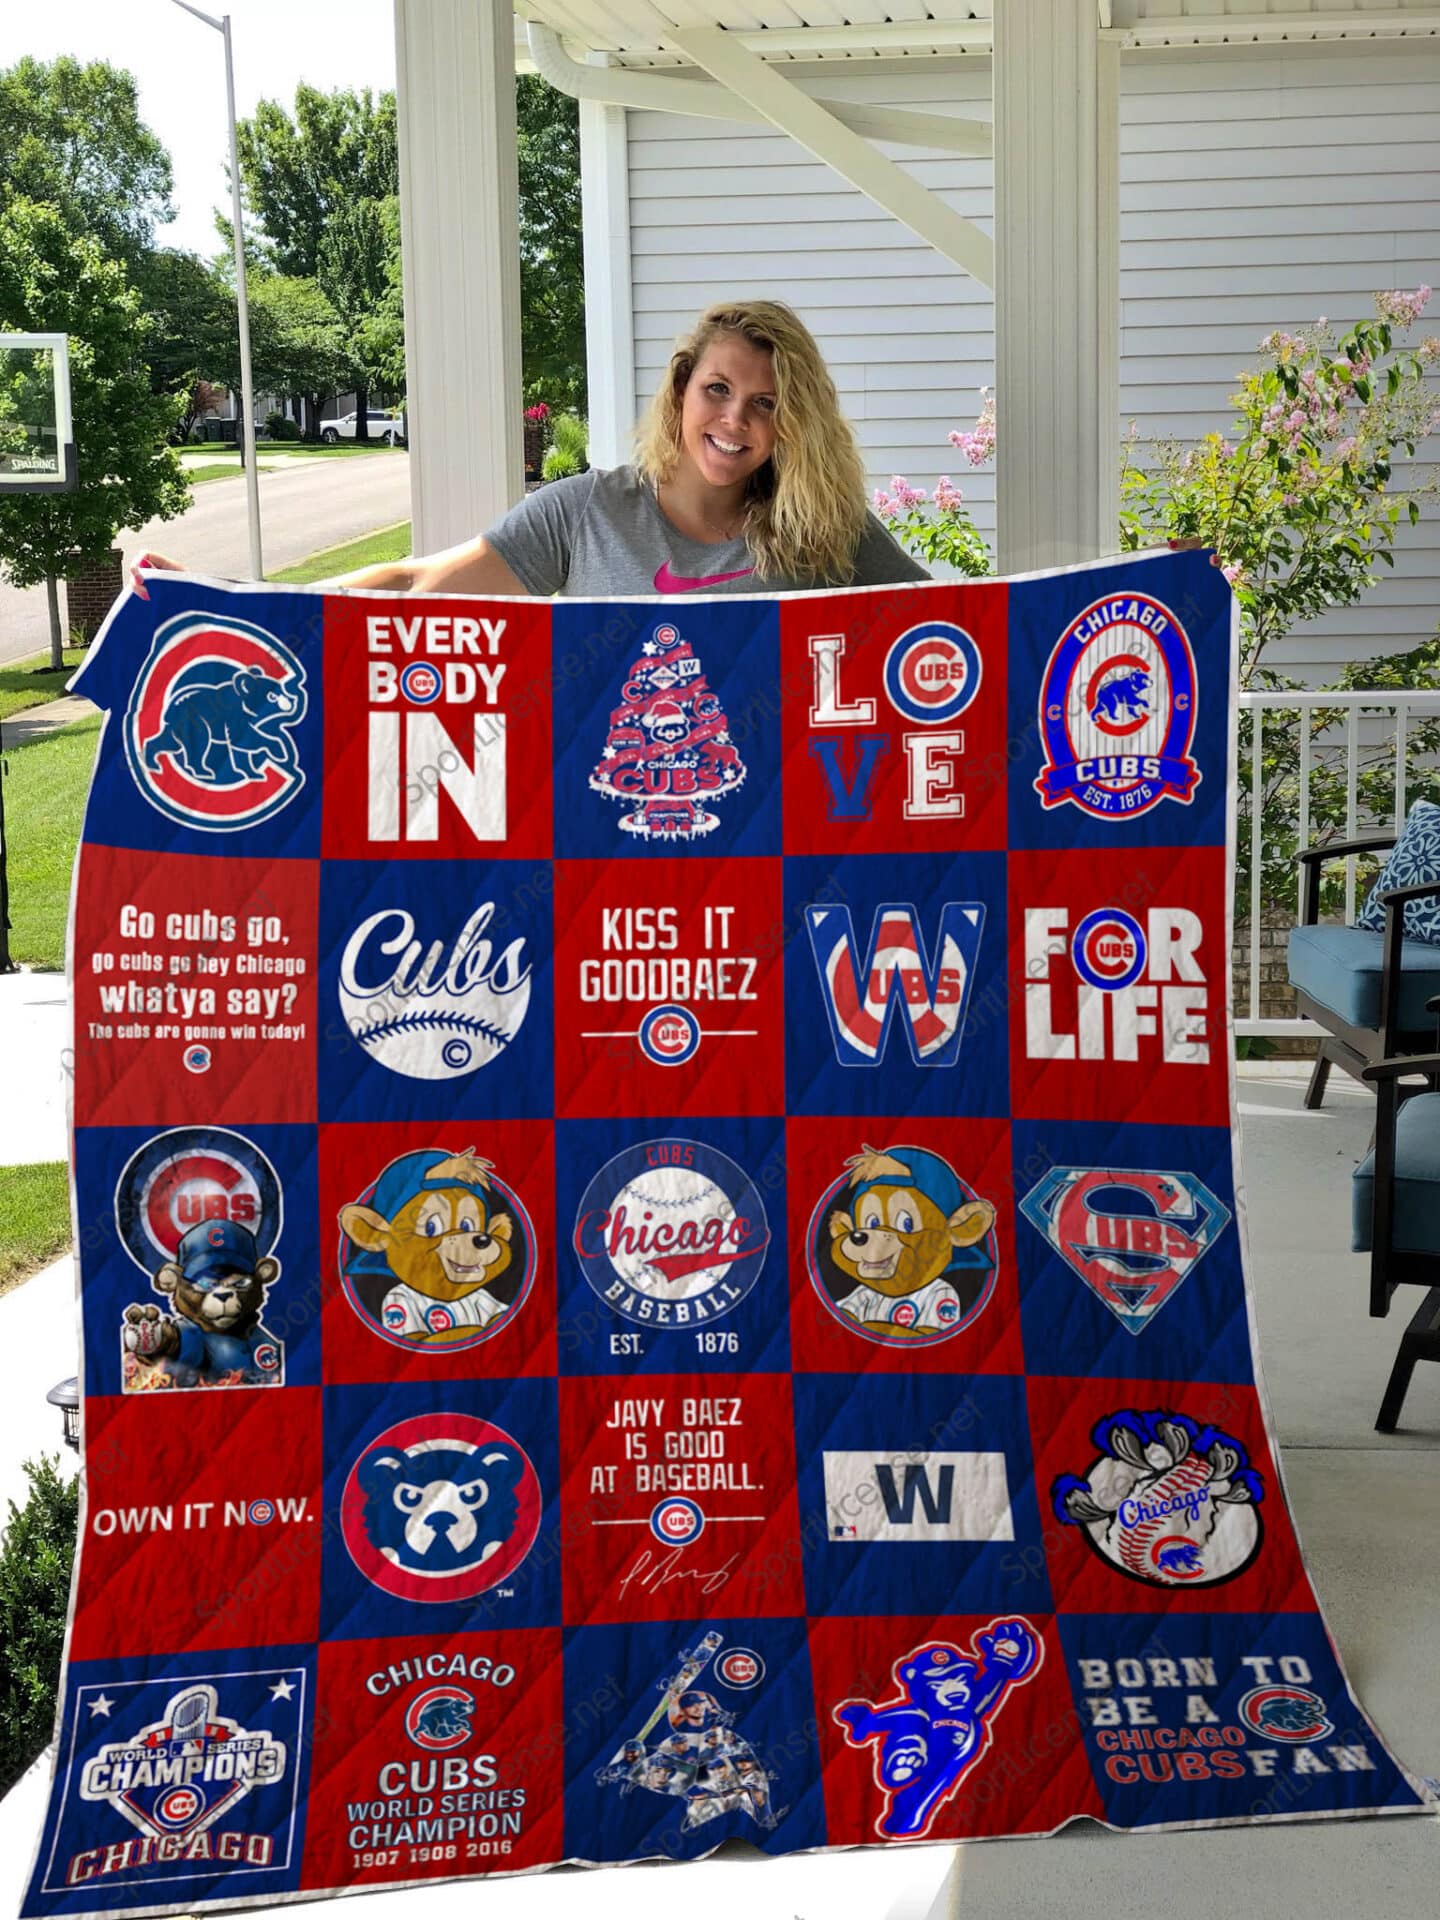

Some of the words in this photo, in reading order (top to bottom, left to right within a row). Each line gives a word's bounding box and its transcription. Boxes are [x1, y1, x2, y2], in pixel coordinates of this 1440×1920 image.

[367, 616, 507, 655] EVERY
[1073, 600, 1168, 643] CHICAGO
[368, 711, 507, 841] IN
[613, 768, 722, 793] CUBS
[648, 760, 698, 769] CHICAGO
[1075, 757, 1161, 783] CUBS
[1083, 786, 1113, 810] EST.
[1120, 784, 1152, 810] 1876
[119, 904, 155, 938] Go
[166, 909, 236, 942] cubs
[247, 916, 289, 947] go,
[602, 907, 678, 950] KISS
[705, 906, 735, 949] IT
[92, 953, 114, 973] go
[120, 951, 163, 971] cubs
[169, 955, 191, 975] go
[197, 954, 230, 976] hey
[236, 954, 306, 976] Chicago
[339, 901, 533, 998] Cubs
[580, 958, 758, 1002] GOODBAEZ
[99, 980, 216, 1019] whatya
[227, 983, 298, 1019] say?
[88, 1022, 113, 1039] The
[117, 1023, 150, 1039] cubs
[155, 1025, 180, 1039] are
[231, 1024, 256, 1039] win
[261, 1023, 305, 1041] today!
[1025, 984, 1210, 1064] LIFE
[645, 1144, 696, 1167] CUBS
[574, 1206, 763, 1266] Chicago
[605, 1280, 742, 1323] BASEBALL
[609, 1333, 645, 1355] EST.
[695, 1332, 740, 1353] 1876
[606, 1399, 665, 1428] JAVY
[682, 1397, 743, 1426] BAEZ
[625, 1432, 647, 1460] IS
[664, 1431, 725, 1459] GOOD
[590, 1465, 619, 1494] AT
[636, 1462, 765, 1492] BASEBALL.
[875, 1463, 955, 1525] W
[93, 1504, 173, 1536] OWN
[184, 1502, 214, 1530] IT
[1118, 1485, 1211, 1529] Chicago
[364, 1652, 517, 1696] CHICAGO
[1078, 1656, 1218, 1689] BORN
[1241, 1655, 1314, 1685] TO
[1085, 1696, 1158, 1726] BE
[1186, 1694, 1220, 1724] A
[109, 1748, 168, 1764] WORLD
[207, 1738, 261, 1755] SERIES
[1096, 1726, 1246, 1751] CHICAGO
[87, 1749, 279, 1794] CHAMPIONS
[378, 1754, 499, 1797] CUBS
[1105, 1751, 1246, 1784] CUBS
[347, 1796, 434, 1823] WORLD
[440, 1788, 527, 1815] SERIES
[349, 1810, 522, 1850] CHAMPION
[65, 1830, 275, 1886] CHICAGO
[352, 1851, 400, 1869] 1907
[409, 1845, 457, 1863] 1908
[466, 1839, 514, 1858] 2016
